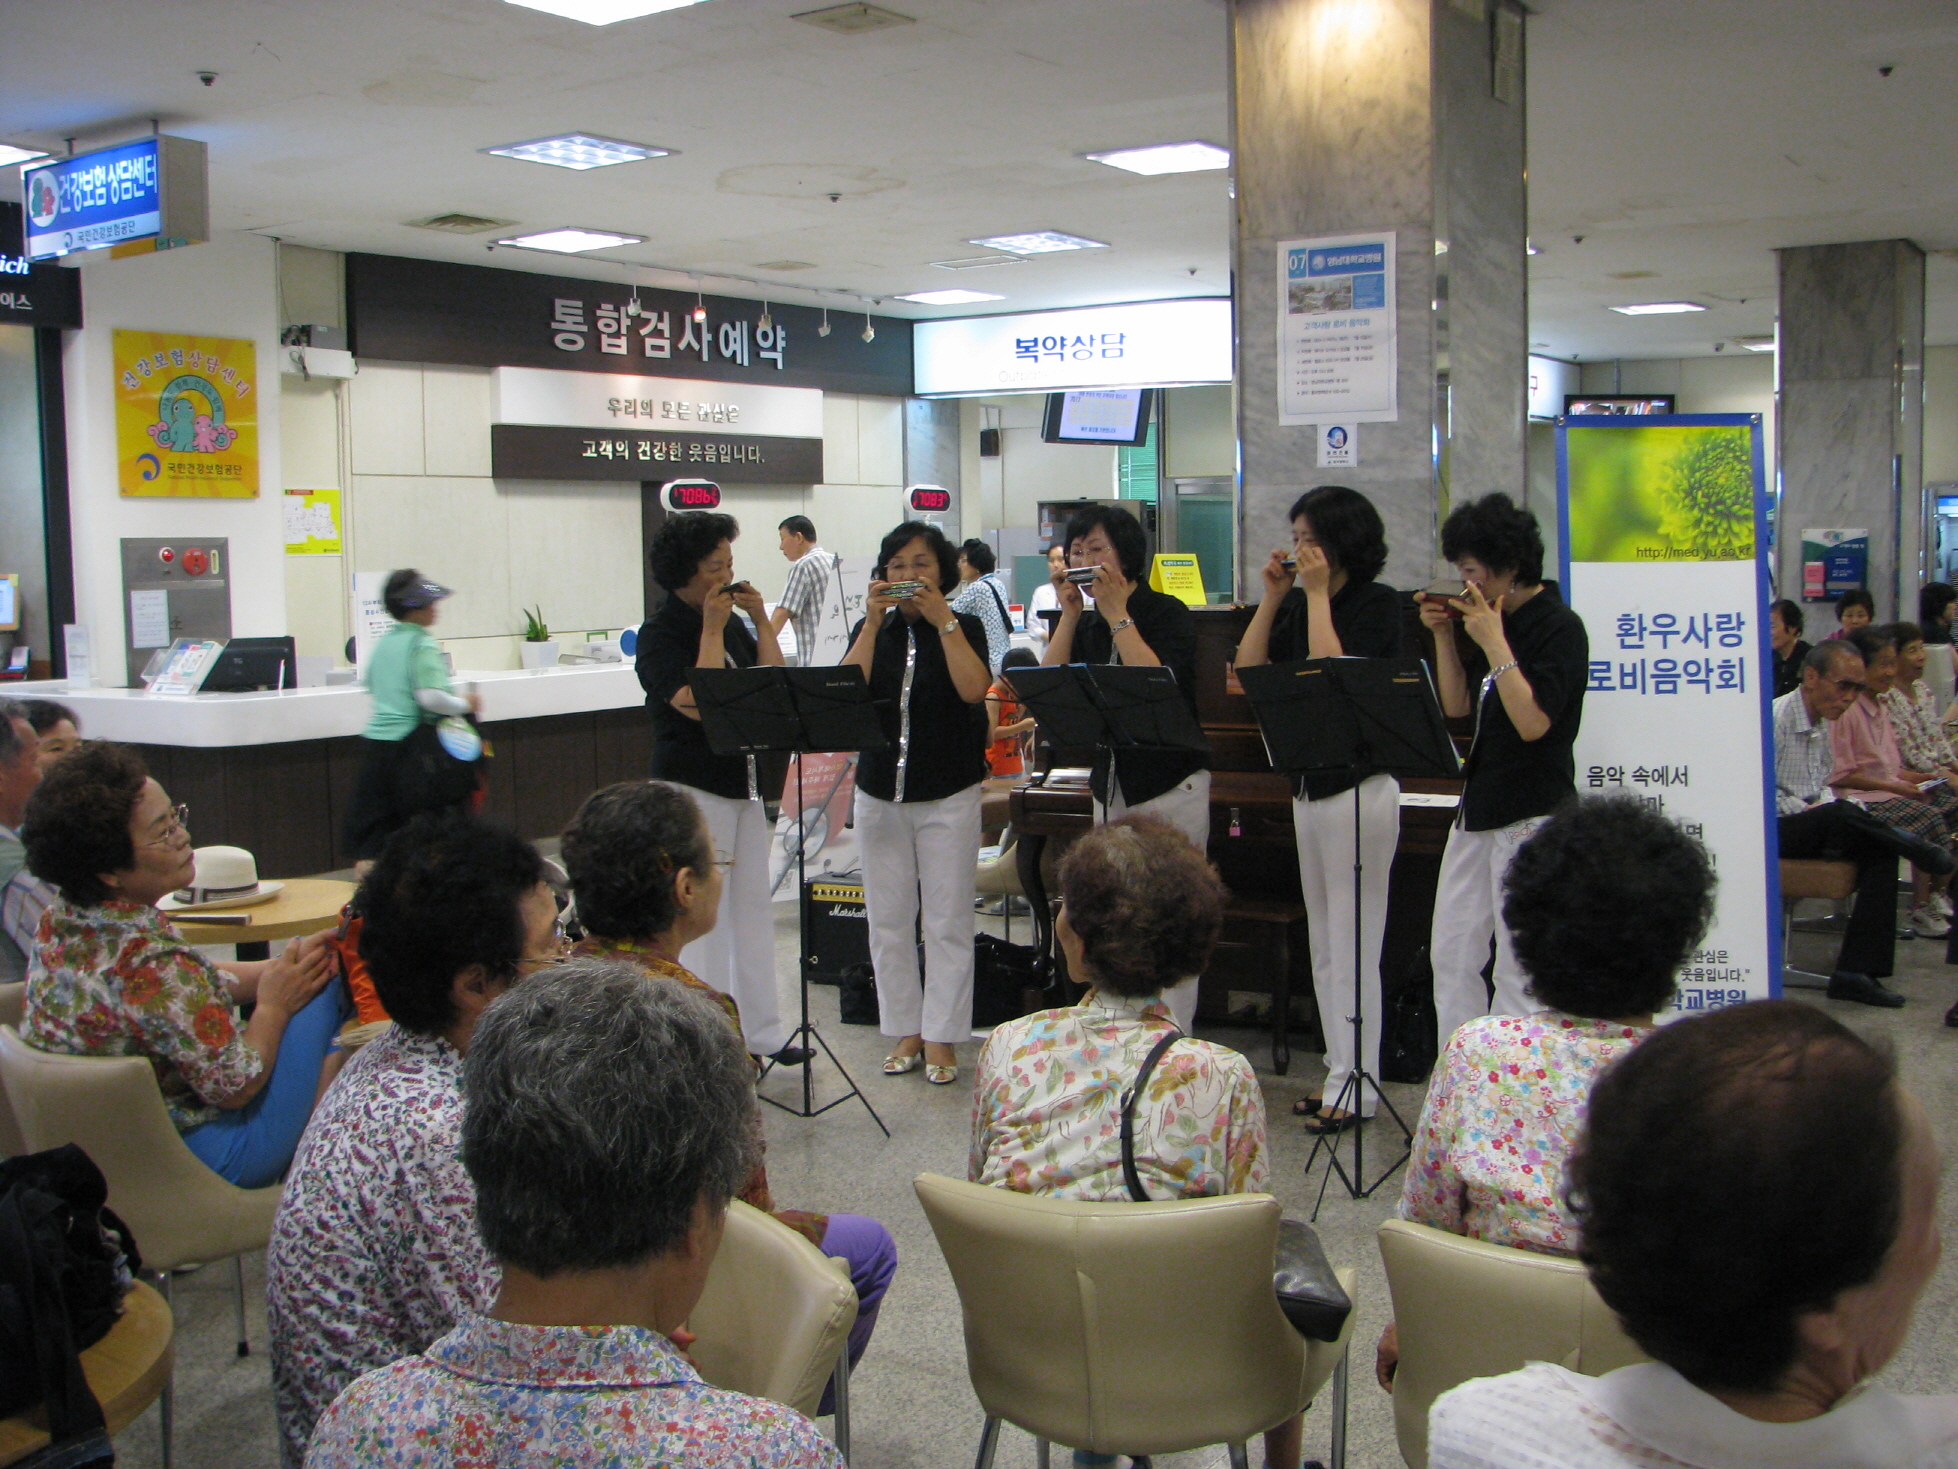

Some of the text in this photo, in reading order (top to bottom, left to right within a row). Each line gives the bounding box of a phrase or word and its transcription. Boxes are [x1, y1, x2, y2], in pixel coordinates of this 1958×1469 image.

[1289, 254, 1306, 270] 07
[551, 298, 786, 370] 통합검사예약
[1015, 332, 1127, 364] 복약상담
[607, 397, 654, 420] 우리의
[661, 400, 692, 421] 모든
[582, 439, 765, 464] 고객의 건강한 웃음입니다.
[167, 462, 243, 476] 국민건강보험공단
[1615, 611, 1746, 650] 환우사랑
[1586, 656, 1745, 695] 로비음악회
[1586, 764, 1689, 788] 음악 속에서
[829, 904, 867, 918] Marshall
